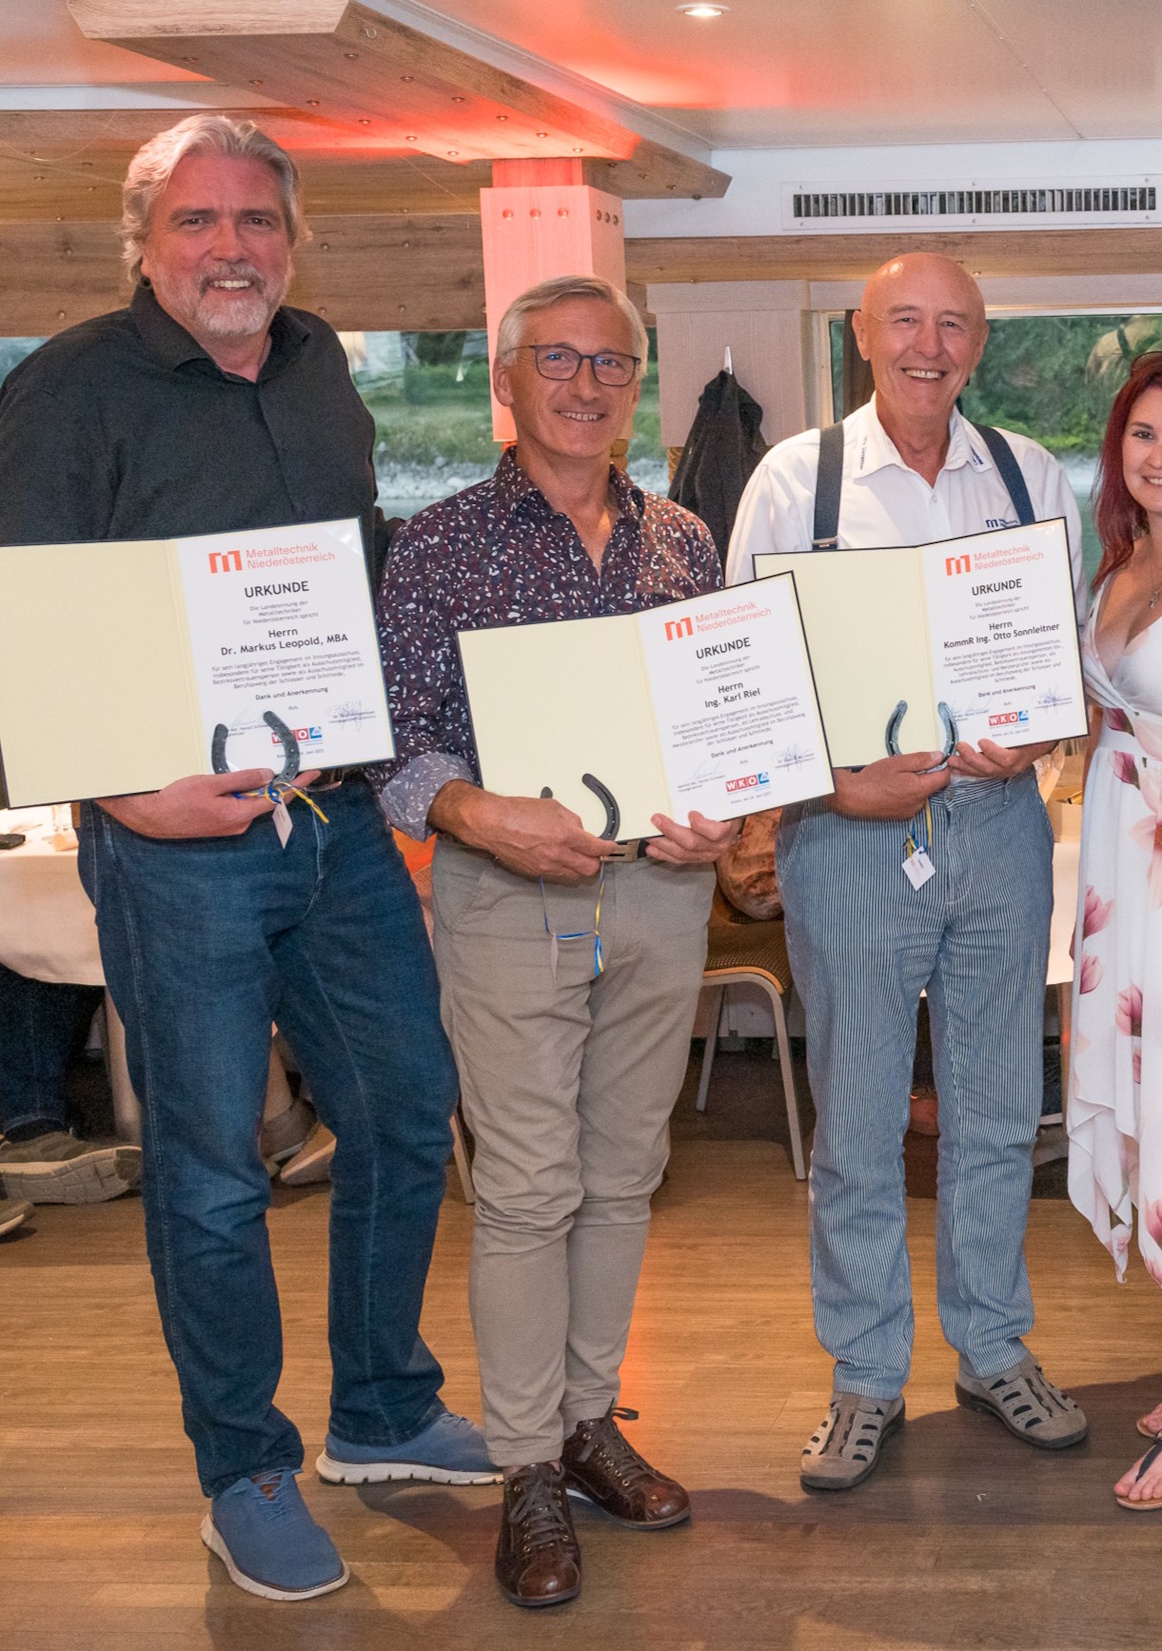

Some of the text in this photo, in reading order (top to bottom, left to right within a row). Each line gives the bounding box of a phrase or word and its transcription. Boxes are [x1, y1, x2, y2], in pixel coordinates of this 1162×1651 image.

[245, 543, 318, 559] Metalltechnik
[973, 544, 1031, 562] Metalltechnik
[247, 552, 336, 569] Niederösterreich
[974, 552, 1044, 571] Niederösterreich
[244, 580, 309, 598] URKUNDE
[971, 578, 1022, 596] URKUNDE
[695, 602, 757, 623] Metalltechnik
[697, 608, 772, 633] Niederösterreich
[268, 628, 299, 639] Herrn
[988, 621, 1013, 631] Herrn
[220, 633, 349, 656] Dr. Markus Leopold, MBA
[943, 624, 1060, 649] KommR Ing. Otto Sonnleitner
[696, 637, 751, 660] URKUNDE
[255, 687, 329, 701] Dank und Anerkennung
[717, 682, 744, 694] Herrn
[1002, 684, 1037, 694] Anerkennung
[704, 687, 761, 709] Ing. Karl Riel
[989, 713, 1017, 725] WKO
[710, 739, 774, 759] Dank und Anerkennung
[726, 776, 757, 791] WKO
